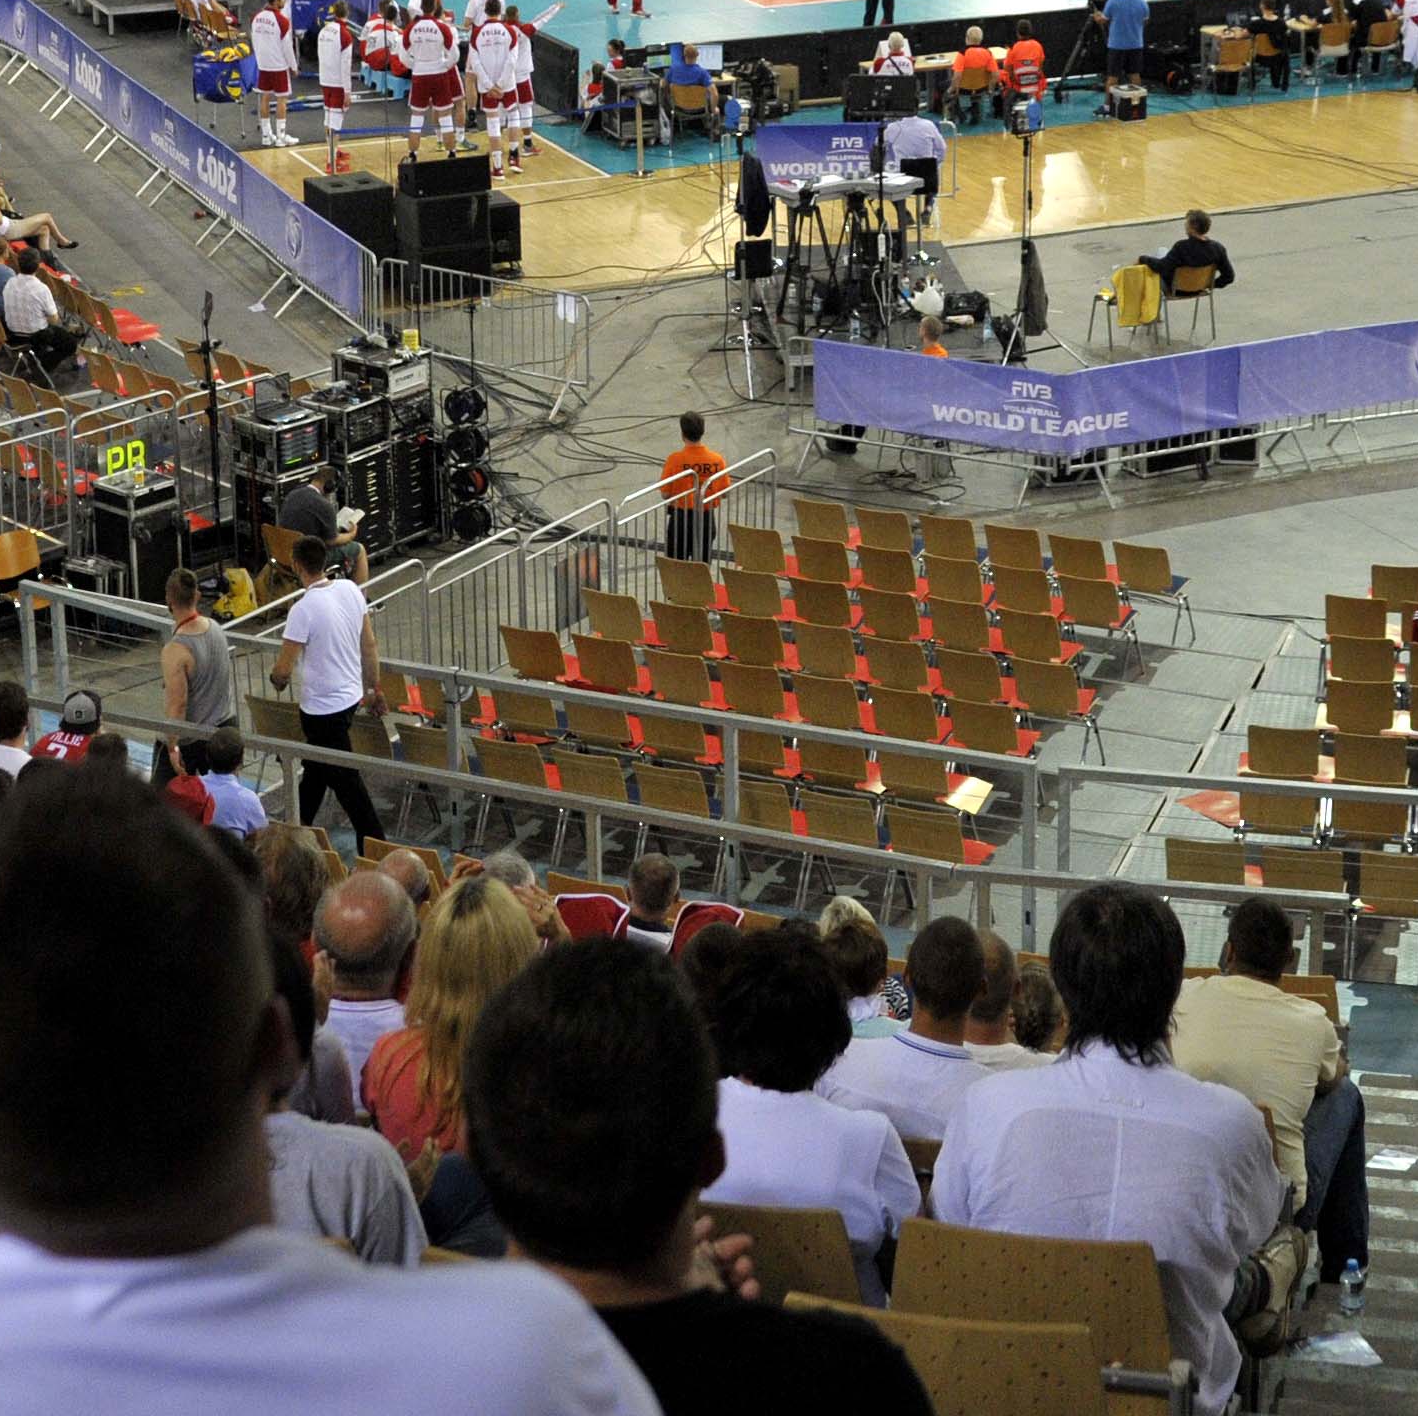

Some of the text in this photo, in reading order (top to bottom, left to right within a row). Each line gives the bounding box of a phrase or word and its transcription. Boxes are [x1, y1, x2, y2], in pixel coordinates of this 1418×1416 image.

[831, 136, 864, 149] FIVB
[196, 147, 238, 205] ŁÓDŹ
[769, 162, 843, 177] WORLD
[1011, 380, 1053, 400] FIVB
[1003, 404, 1062, 418] VOLLEYBALL
[931, 404, 1130, 437] WORLD LEAGUE
